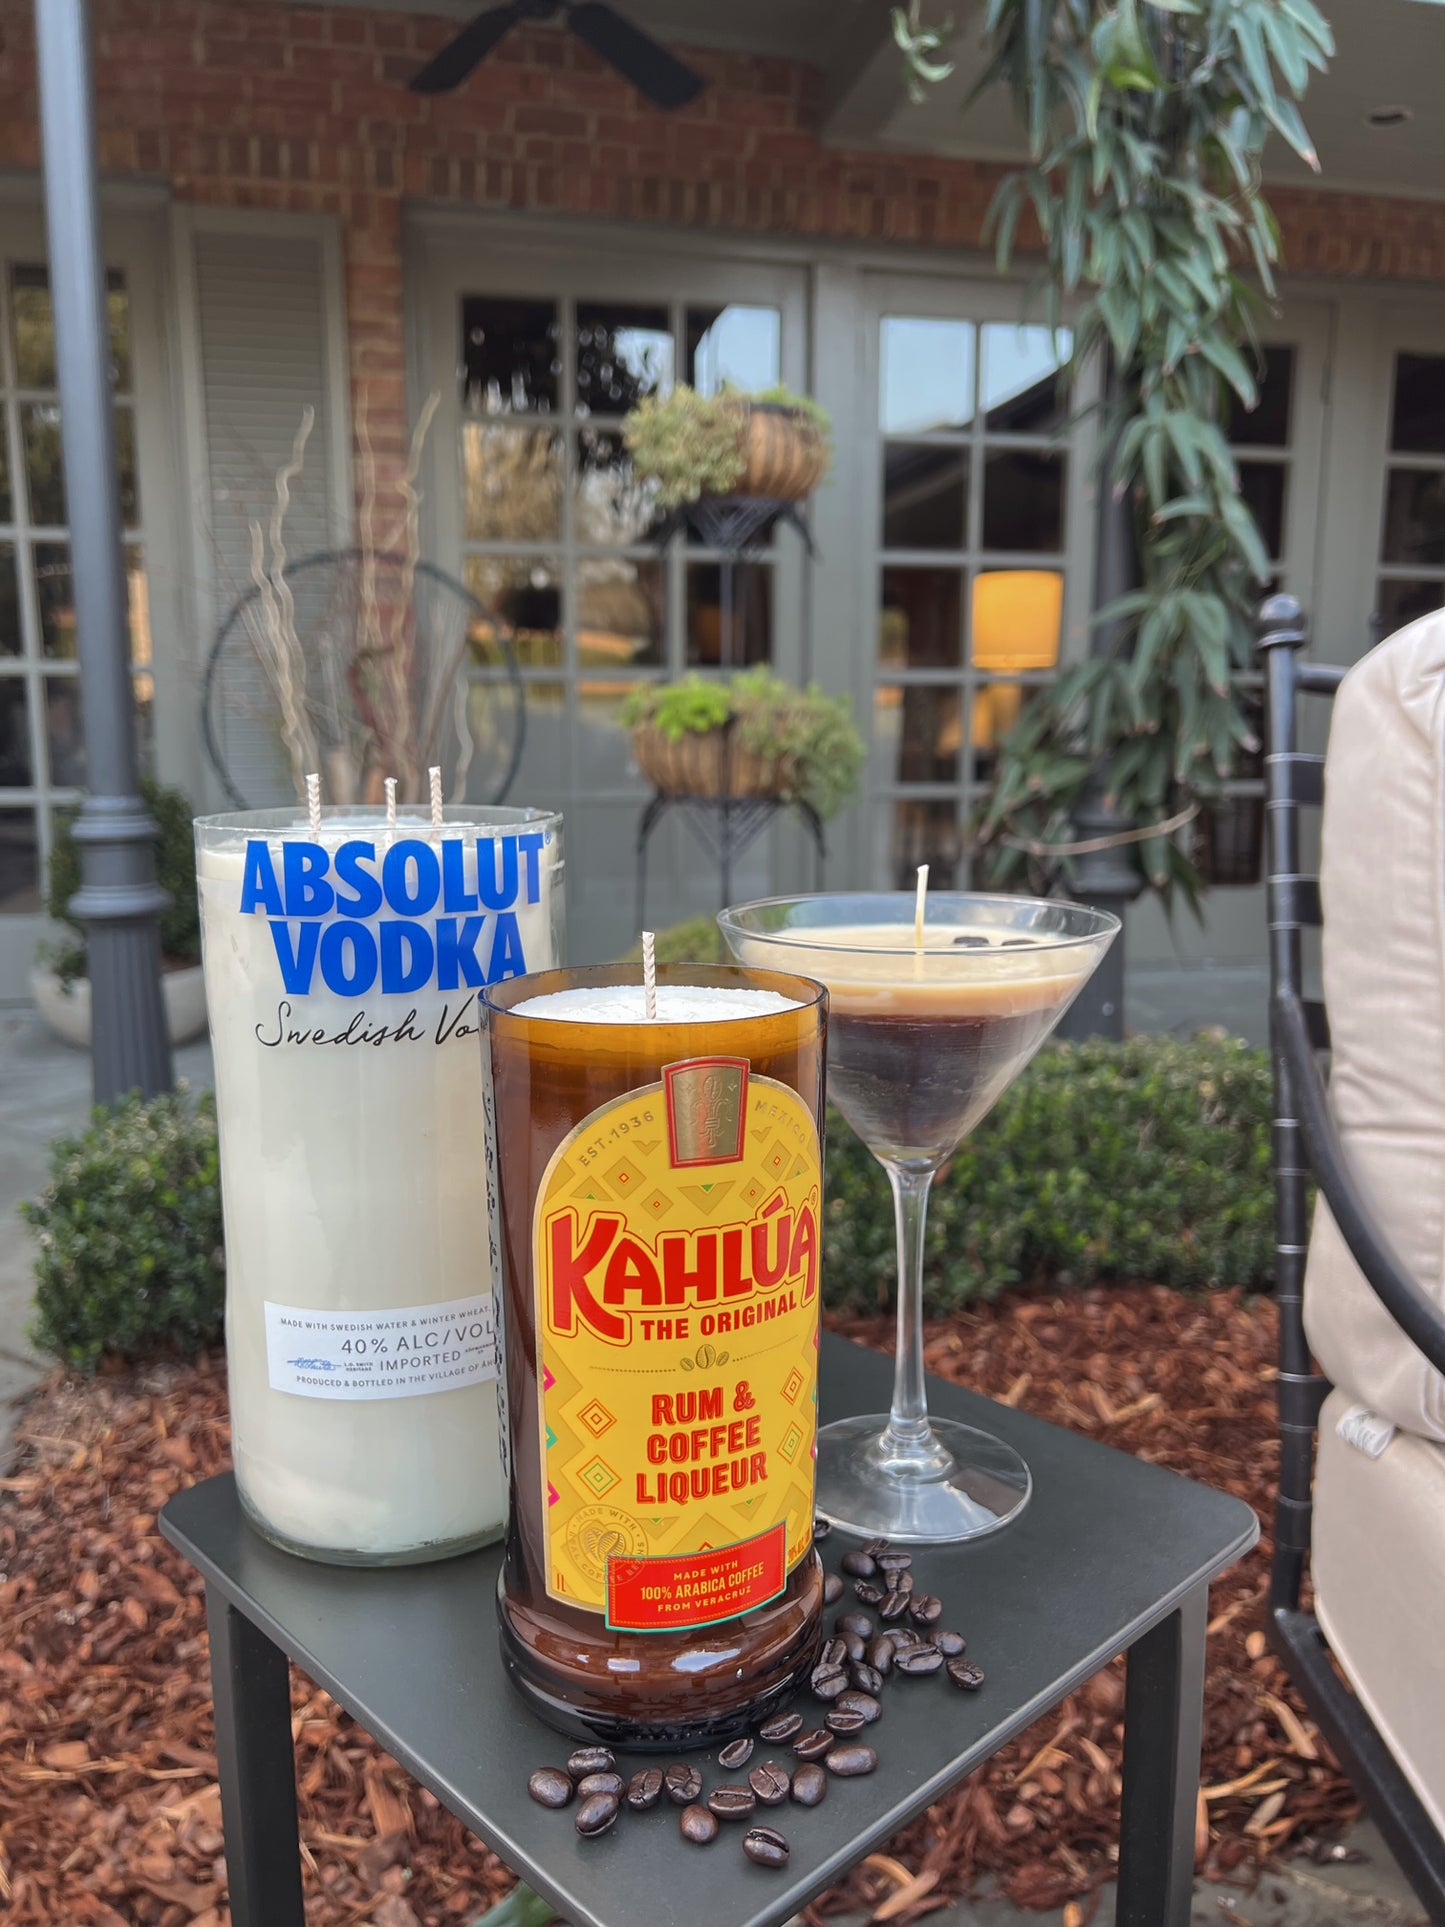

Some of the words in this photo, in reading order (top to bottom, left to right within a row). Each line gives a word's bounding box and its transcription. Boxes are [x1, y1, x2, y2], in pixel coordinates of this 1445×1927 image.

[240, 832, 545, 919] ABSOLUT
[268, 911, 527, 997] VODKA
[255, 1001, 426, 1047] Swedish
[436, 994, 480, 1045] Vo
[755, 1099, 807, 1145] MEXICO
[550, 1192, 818, 1341] KAHLÚA
[281, 1318, 303, 1329] MADE
[305, 1321, 328, 1331] WITH
[330, 1322, 373, 1332] SWEDISH
[376, 1320, 408, 1330] WATER
[411, 1319, 417, 1327] &
[420, 1313, 456, 1326] WINTER
[640, 1317, 689, 1341] THE
[700, 1290, 797, 1337] ORIGINAL
[341, 1337, 388, 1354] 40%
[380, 1350, 461, 1371] IMPORTED
[296, 1375, 342, 1387] PRODUCED
[344, 1379, 350, 1387] &
[353, 1378, 393, 1387] BOTTLED
[396, 1376, 405, 1385] IN
[408, 1374, 426, 1383] THE
[429, 1366, 466, 1380] VILLAGE
[468, 1362, 479, 1372] OF
[651, 1386, 724, 1427] RUM
[733, 1380, 756, 1412] &
[646, 1414, 761, 1466] COFFEE
[636, 1451, 768, 1506] LIQUEUR
[609, 1509, 638, 1531] WITH
[640, 1585, 672, 1601] 100%
[675, 1579, 726, 1600] ARABICA
[728, 1562, 765, 1588] COFFEE
[673, 1567, 707, 1582] MADE
[710, 1560, 739, 1574] WITH
[657, 1601, 691, 1613] FROM
[694, 1585, 752, 1609] VERACRUZ
